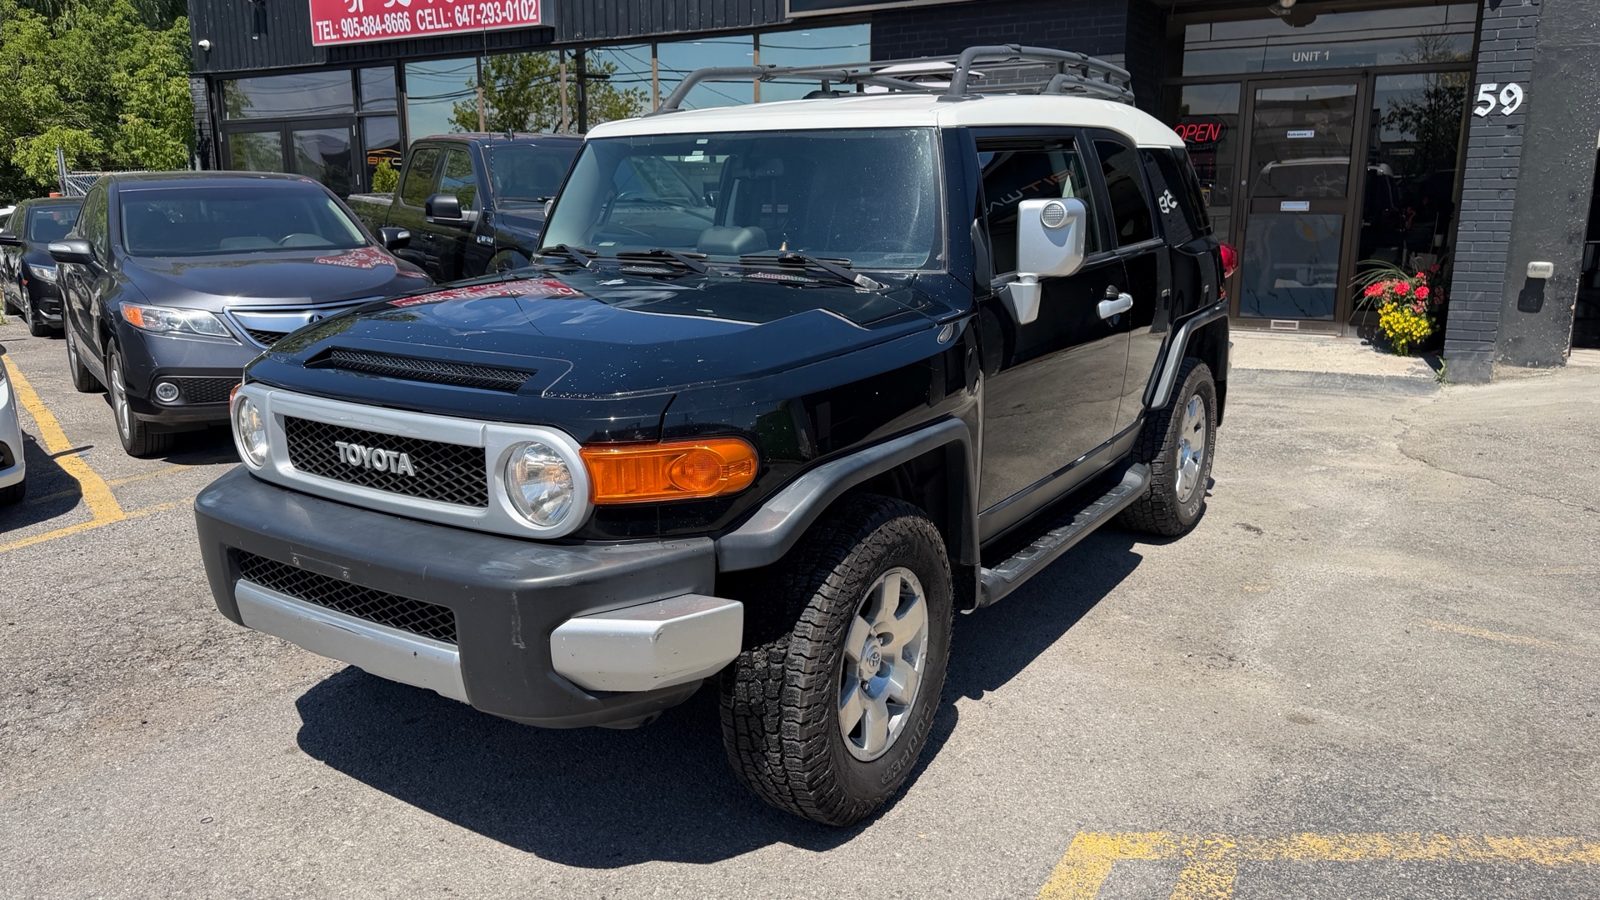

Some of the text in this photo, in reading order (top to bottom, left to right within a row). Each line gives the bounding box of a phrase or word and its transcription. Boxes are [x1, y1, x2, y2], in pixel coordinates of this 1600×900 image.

[316, 20, 340, 40] TEL:
[340, 11, 411, 38] 905-884-8666
[416, 8, 452, 30] CELL:
[454, 0, 537, 27] 647-293-0102
[1292, 50, 1330, 63] UNIT 1
[1473, 82, 1524, 117] 59
[1174, 123, 1222, 142] OPEN
[335, 441, 415, 476] TOYOTA
